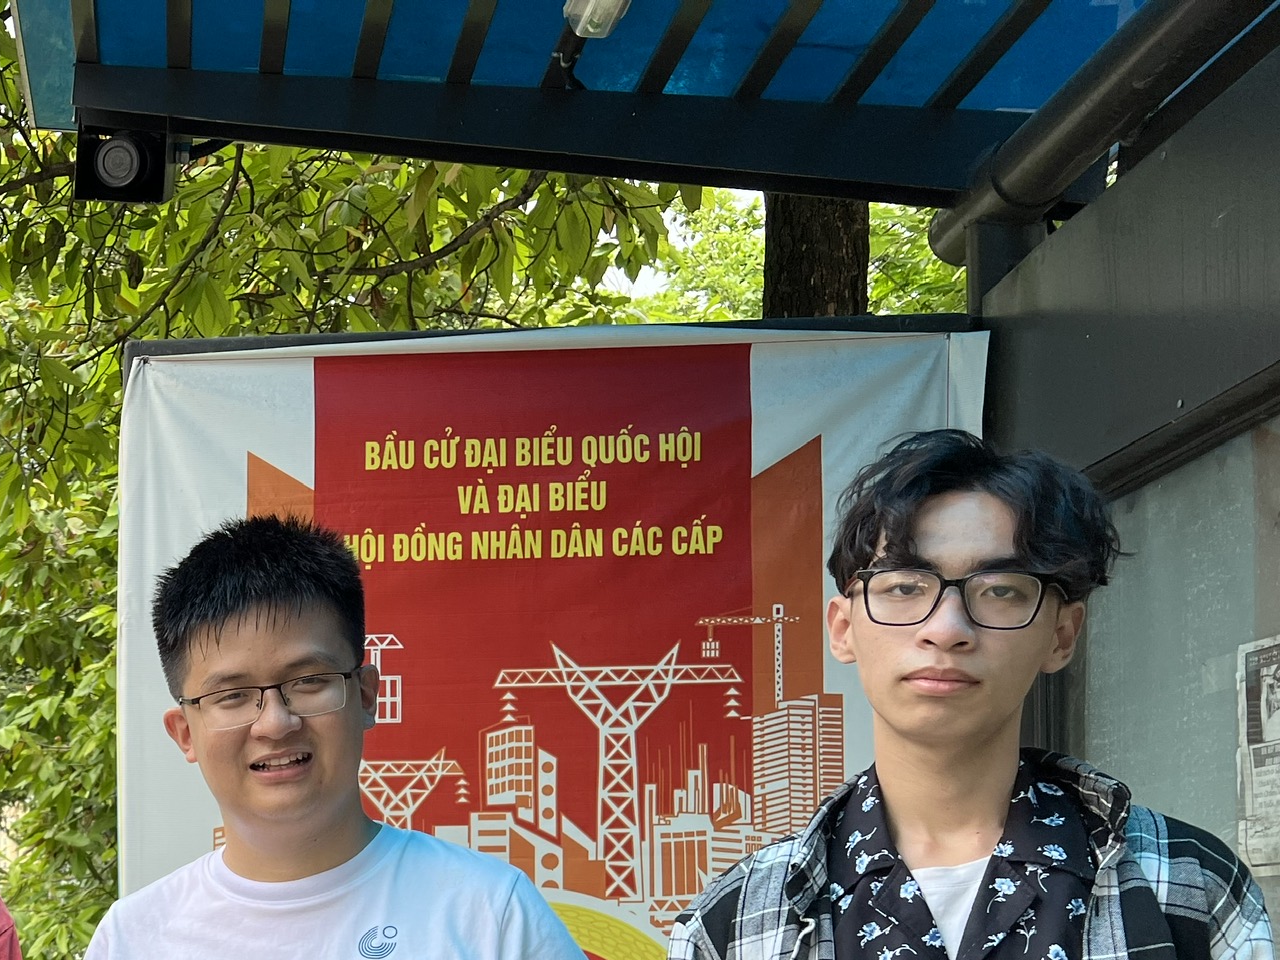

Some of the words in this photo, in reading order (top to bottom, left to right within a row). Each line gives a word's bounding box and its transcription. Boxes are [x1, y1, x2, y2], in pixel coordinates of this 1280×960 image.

[365, 430, 415, 471] BẦU
[423, 425, 461, 469] CỬ
[464, 438, 507, 474] ĐẠI
[515, 424, 573, 467] BIỂU
[581, 423, 651, 466] QUỐC
[659, 425, 702, 469] HỘI
[457, 478, 490, 515] VÀ
[497, 482, 540, 519] ĐẠI
[549, 469, 608, 512] BIỂU
[392, 522, 462, 563] ĐỒNG
[471, 523, 542, 560] NHÂN
[550, 522, 603, 559] DÂN
[612, 520, 664, 557] CÁC
[671, 515, 724, 556] CẤP
